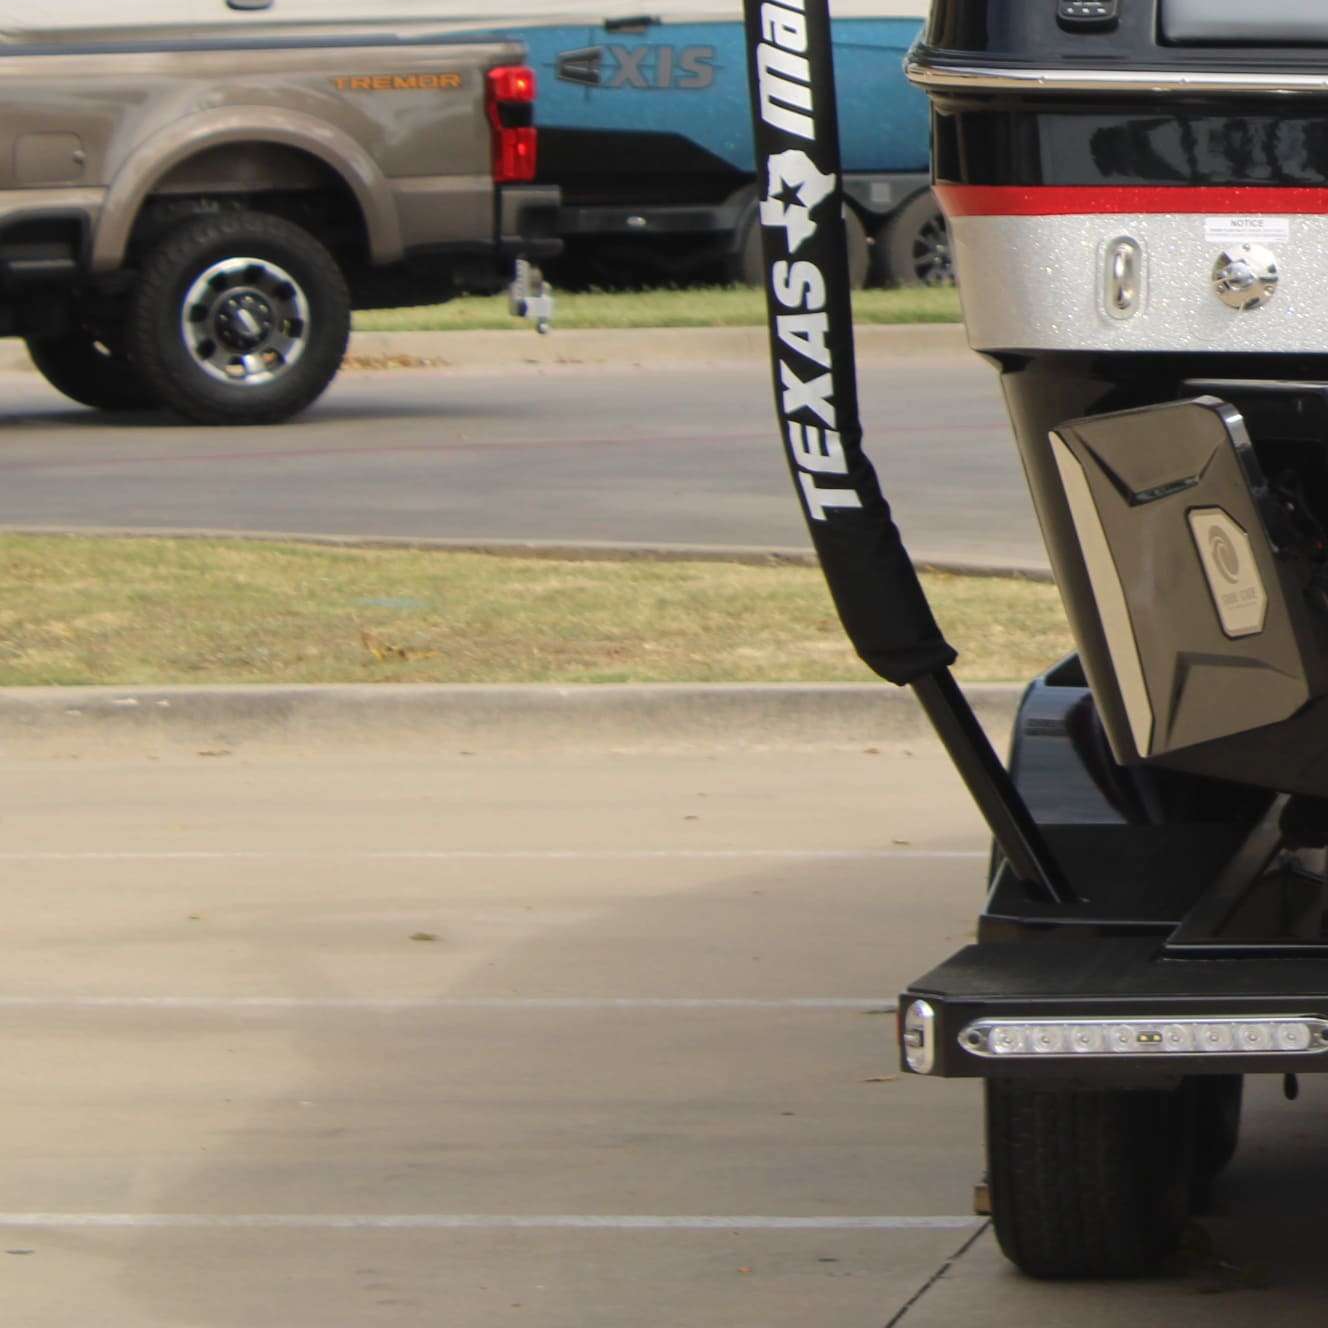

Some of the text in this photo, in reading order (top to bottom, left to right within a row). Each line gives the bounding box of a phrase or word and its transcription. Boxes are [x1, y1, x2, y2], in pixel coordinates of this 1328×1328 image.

[333, 73, 463, 91] TREMOR
[1230, 218, 1265, 228] NOTICE
[770, 257, 863, 522] TEXAS
